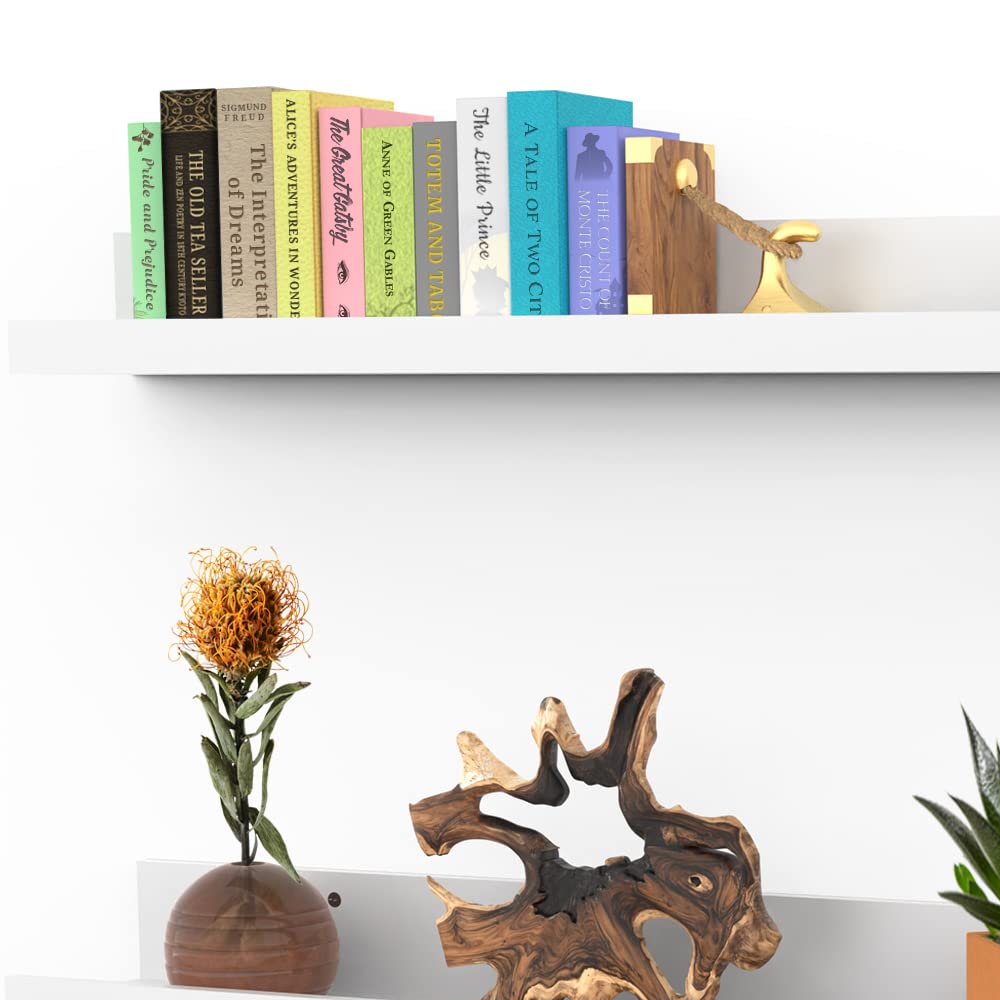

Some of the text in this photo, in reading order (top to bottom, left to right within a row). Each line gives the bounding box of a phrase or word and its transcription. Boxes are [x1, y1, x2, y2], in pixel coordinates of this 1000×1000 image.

[221, 102, 267, 112] SIGMUND
[224, 113, 265, 122] FREUD
[524, 122, 539, 137] A
[175, 171, 184, 187] AND
[250, 143, 267, 183] The
[329, 116, 354, 246] The Great Gatsby
[472, 107, 494, 260] The Little Prince
[524, 142, 539, 192] TALE
[188, 149, 208, 315] THE OLD TEA SELLER
[228, 177, 245, 287] of Dreams
[286, 99, 300, 318] ALICE'S ADVENTURES IN WONDE
[425, 137, 445, 317] TOTEM AND TAB
[525, 198, 539, 223] OF
[596, 190, 609, 223] THE
[141, 157, 158, 311] Pride and Prejudice
[527, 229, 542, 275] TWO
[577, 190, 593, 311] MONTE CRISTO
[598, 226, 611, 284] COUNT
